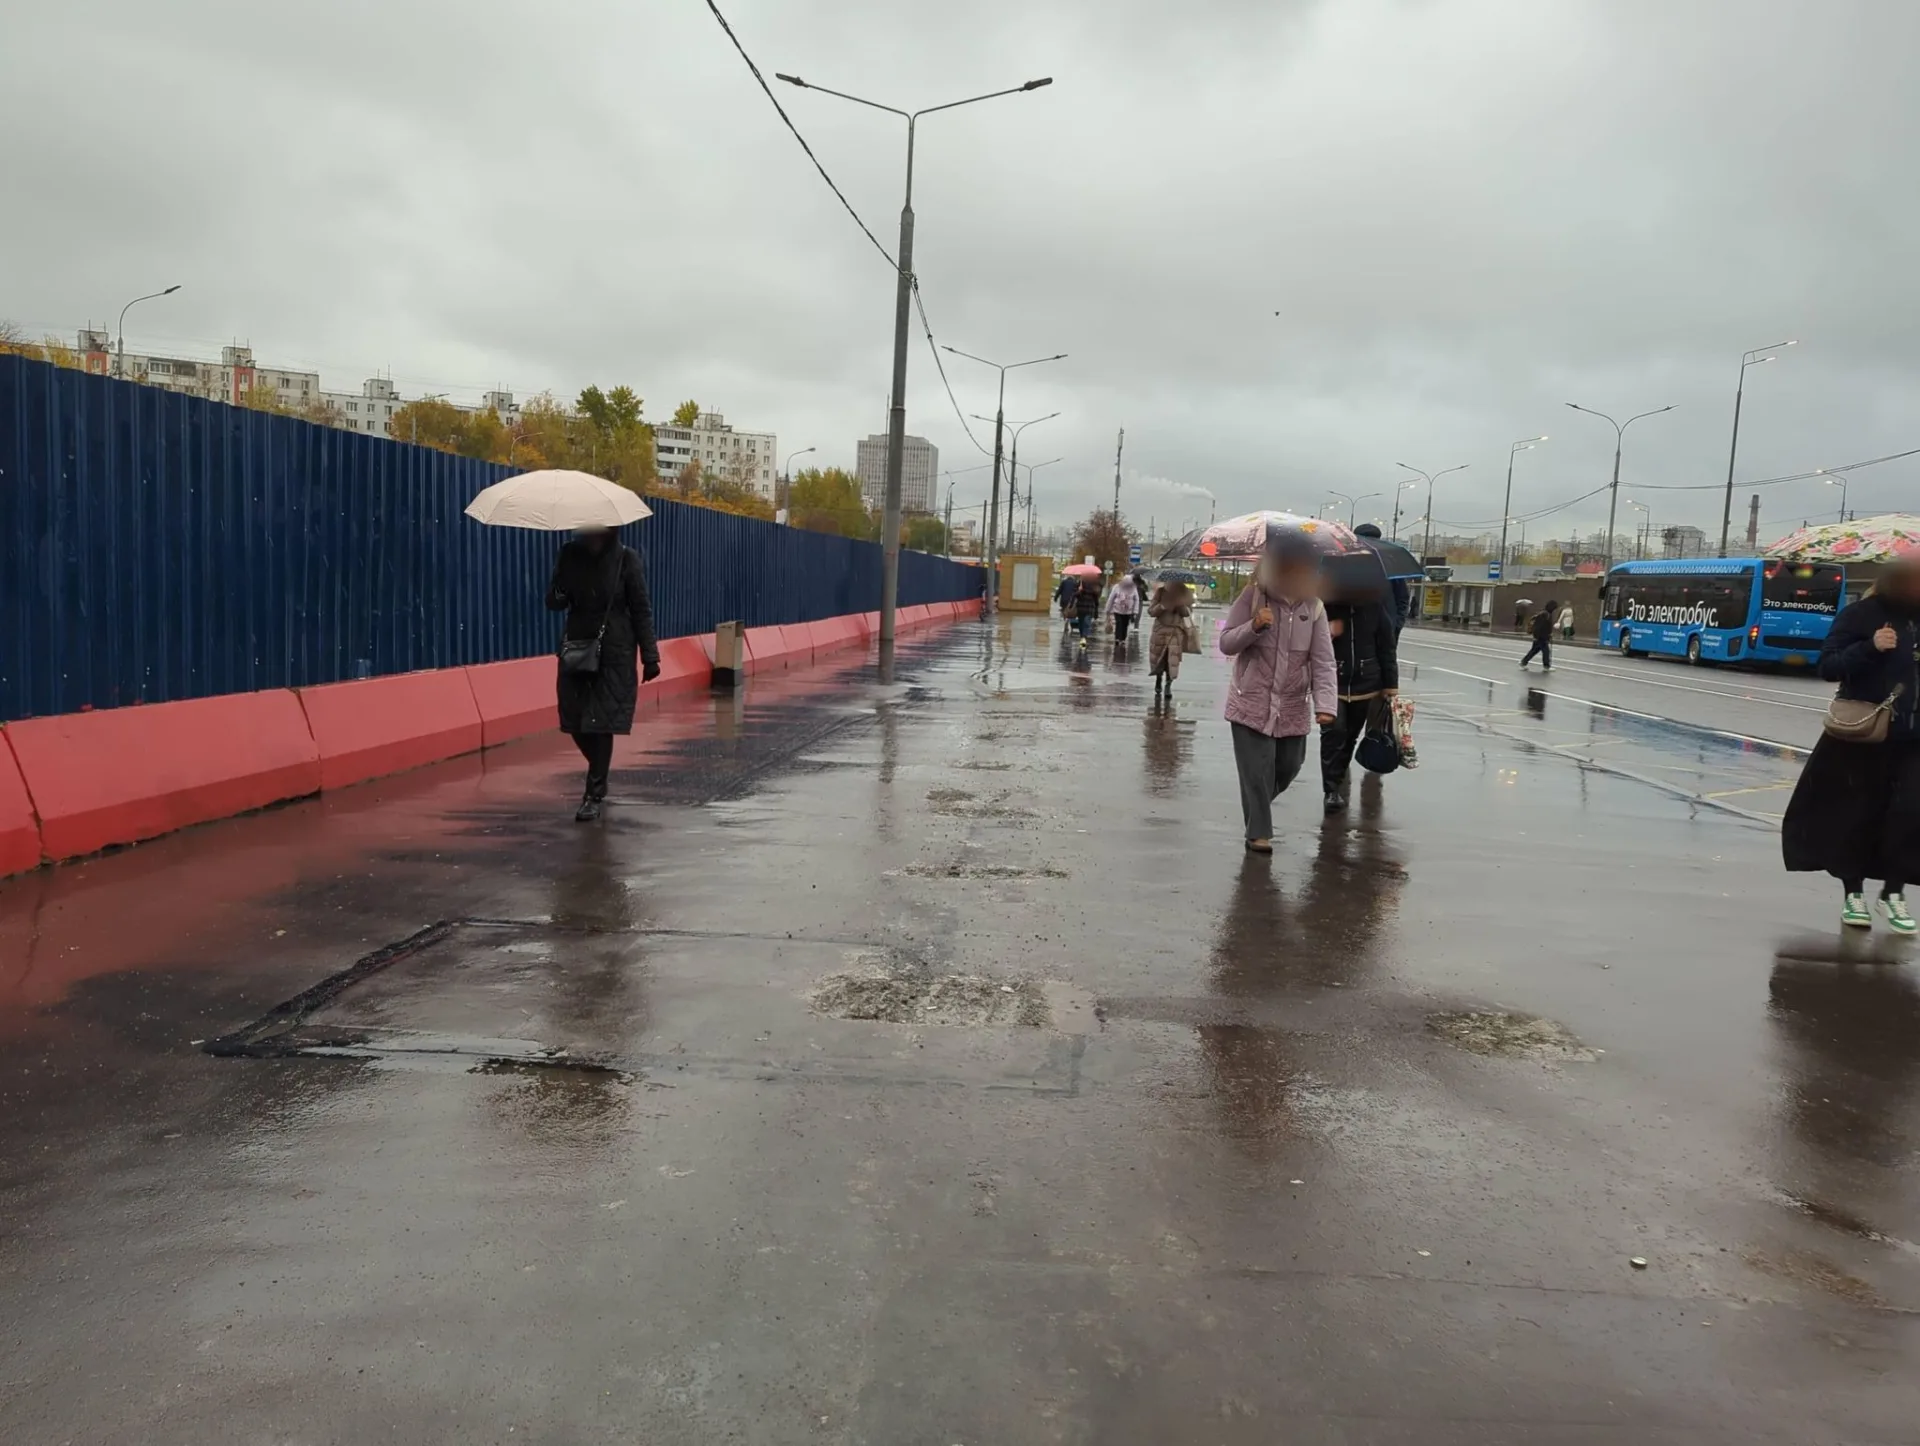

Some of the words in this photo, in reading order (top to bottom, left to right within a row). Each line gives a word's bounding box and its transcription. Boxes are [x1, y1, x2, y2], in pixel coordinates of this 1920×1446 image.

[1626, 598, 1646, 621] Это
[1647, 600, 1719, 632] электробус.
[1763, 598, 1781, 608] Это
[1782, 601, 1836, 613] электробус.
